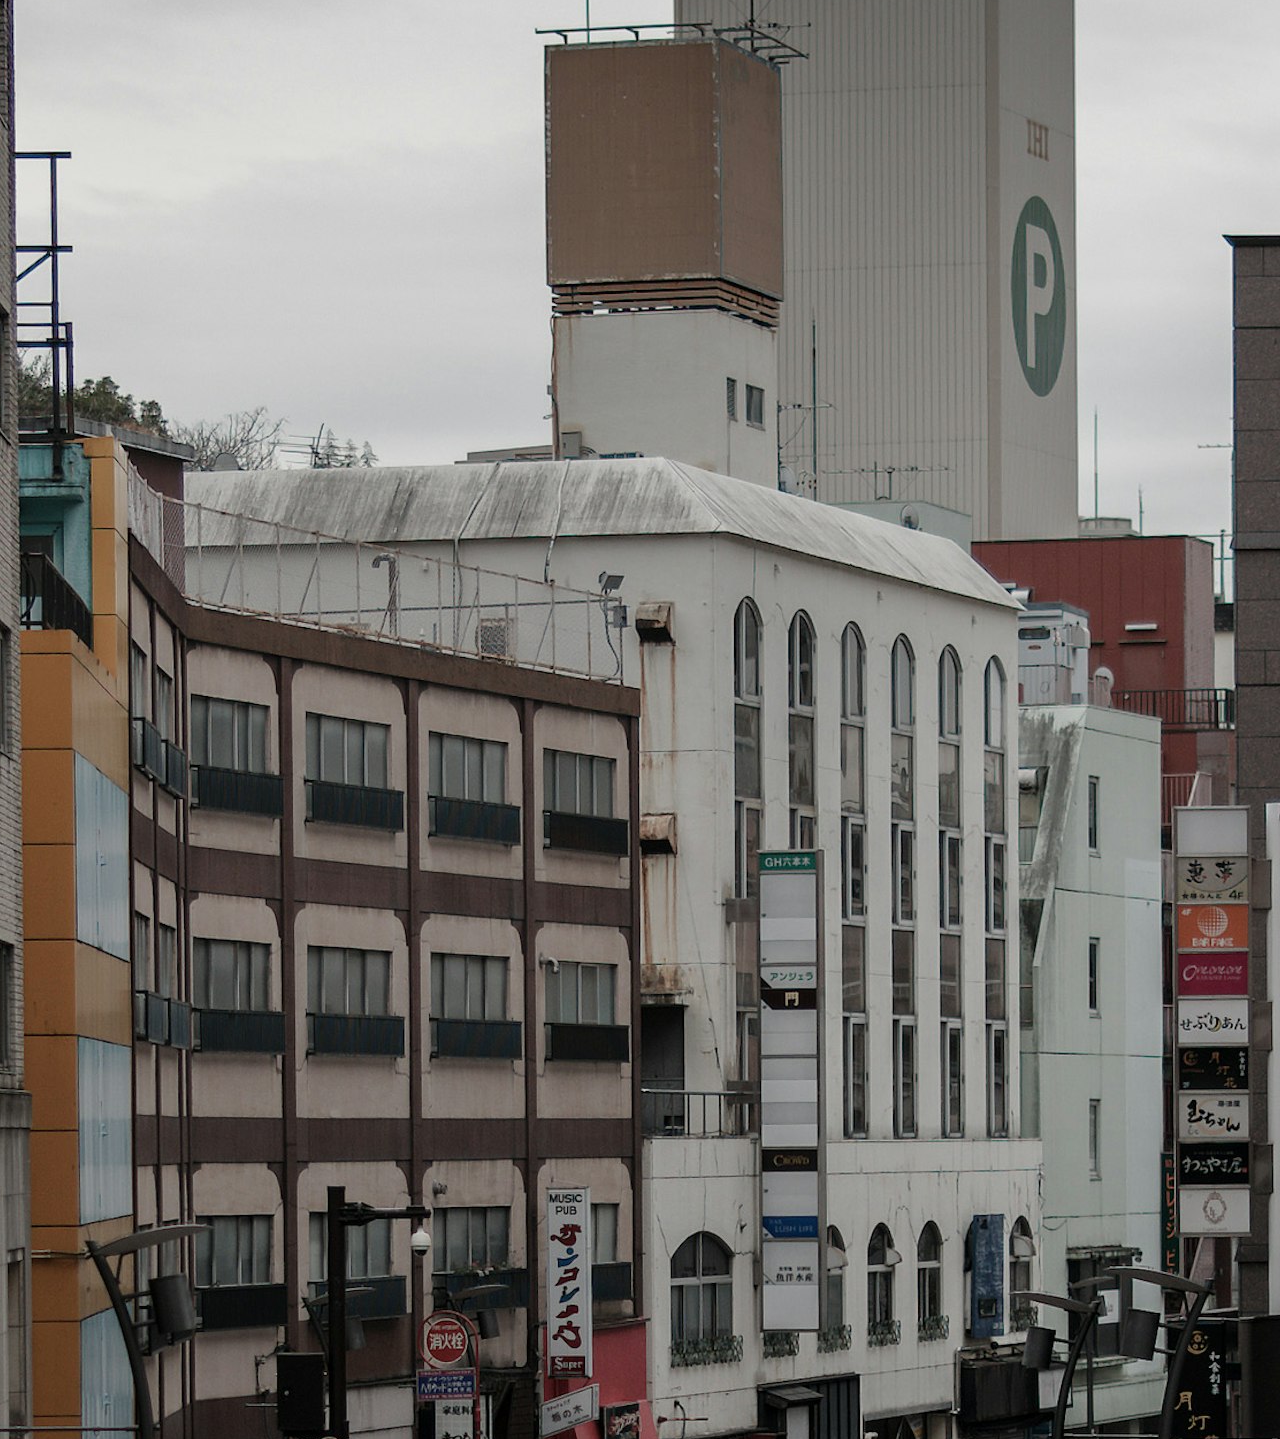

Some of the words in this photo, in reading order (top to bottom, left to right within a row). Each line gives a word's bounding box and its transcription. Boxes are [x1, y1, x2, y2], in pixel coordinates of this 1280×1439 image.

[550, 1194, 583, 1204] MUSIC
[555, 1206, 577, 1215] PUB
[429, 1332, 465, 1350] 消火栓
[443, 1405, 475, 1415] 家庭料
